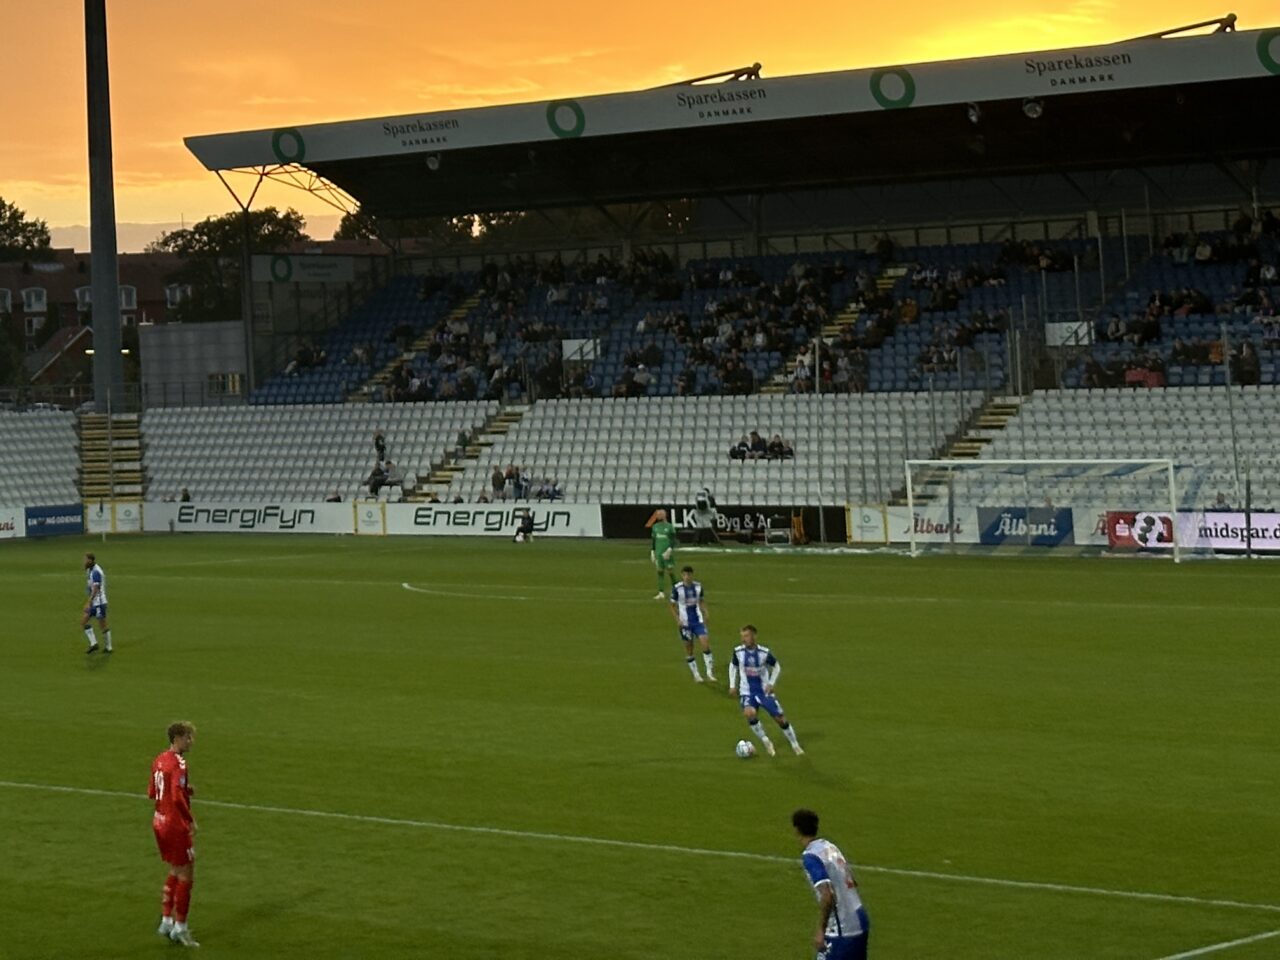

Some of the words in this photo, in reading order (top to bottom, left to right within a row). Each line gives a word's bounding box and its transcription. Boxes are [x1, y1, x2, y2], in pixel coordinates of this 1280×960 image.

[1024, 53, 1132, 76] Sparekassen
[1050, 73, 1114, 86] DANMARK
[676, 88, 766, 109] Sparekassen
[698, 107, 752, 118] DANMARK
[383, 119, 459, 138] Sparekassen
[743, 513, 754, 529] &
